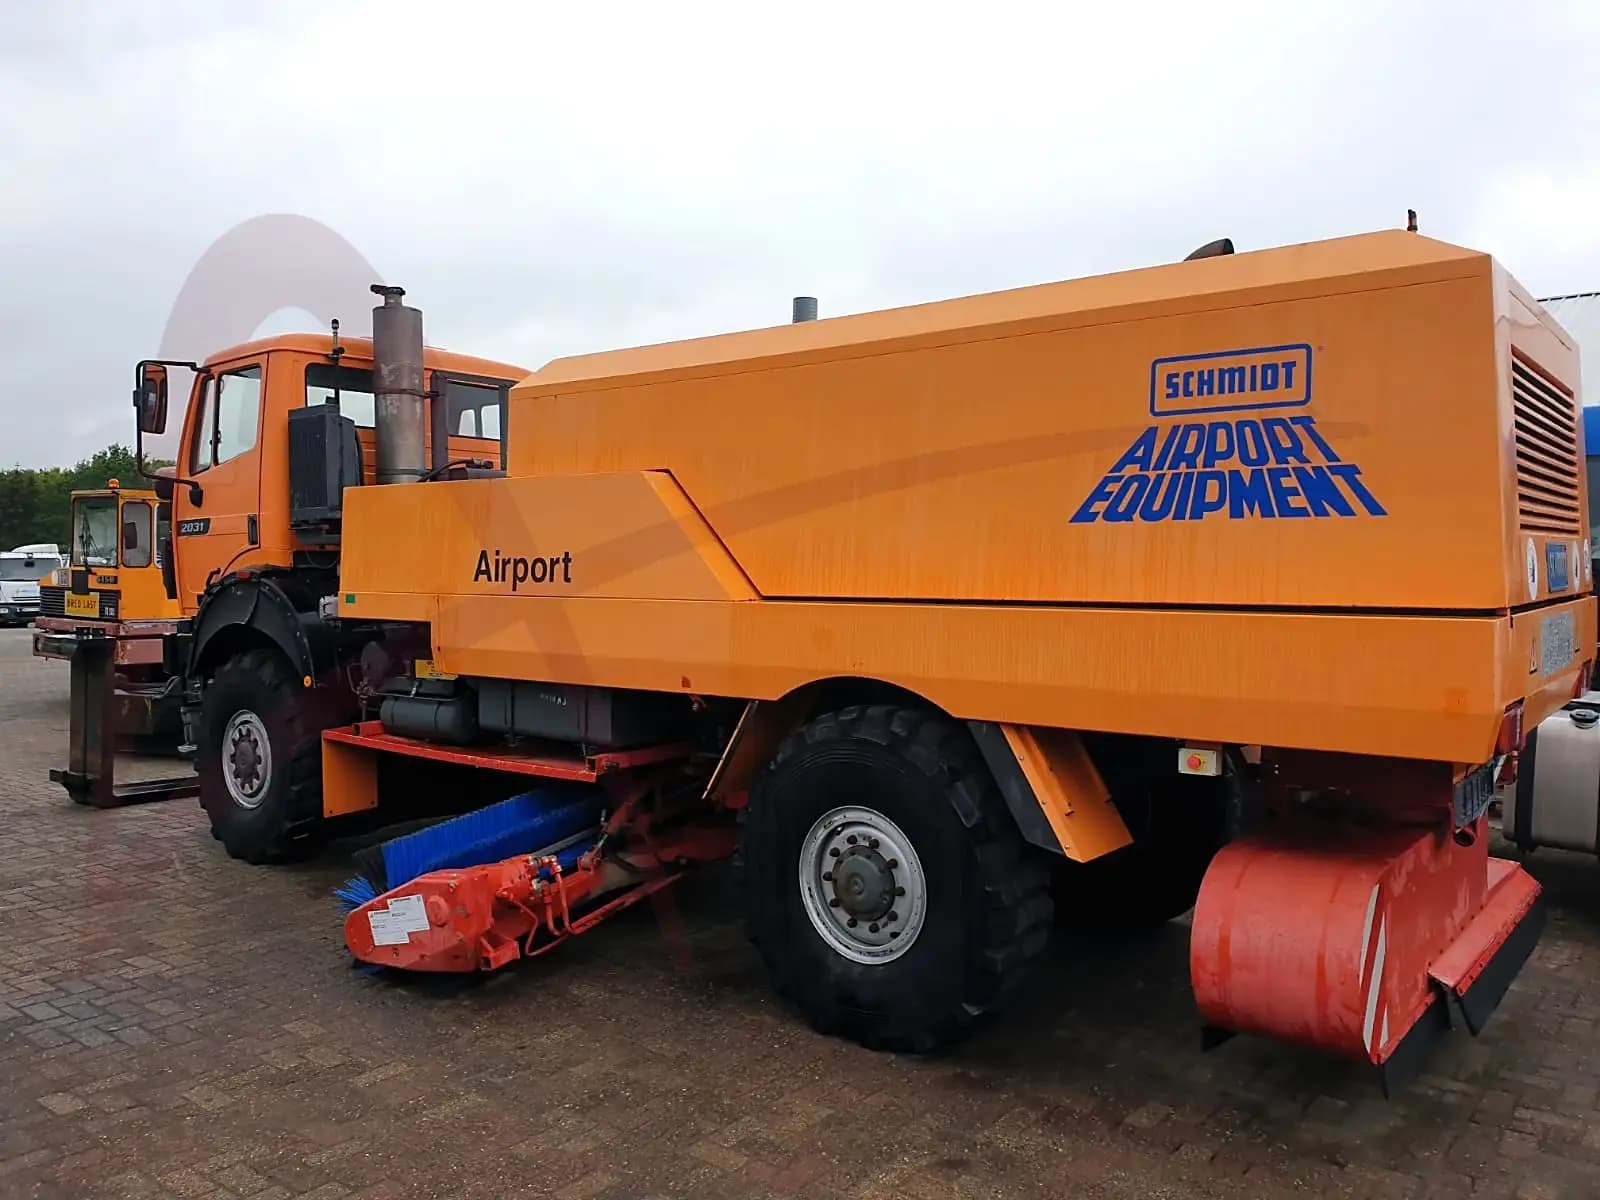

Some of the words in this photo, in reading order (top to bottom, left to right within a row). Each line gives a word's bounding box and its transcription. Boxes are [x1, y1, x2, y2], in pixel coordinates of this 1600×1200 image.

[1165, 360, 1297, 399] SCHMIDT
[1107, 415, 1341, 474] AIRPORT
[1068, 463, 1388, 524] EQUIPMENT
[181, 522, 204, 533] 2031
[473, 549, 572, 592] Airport
